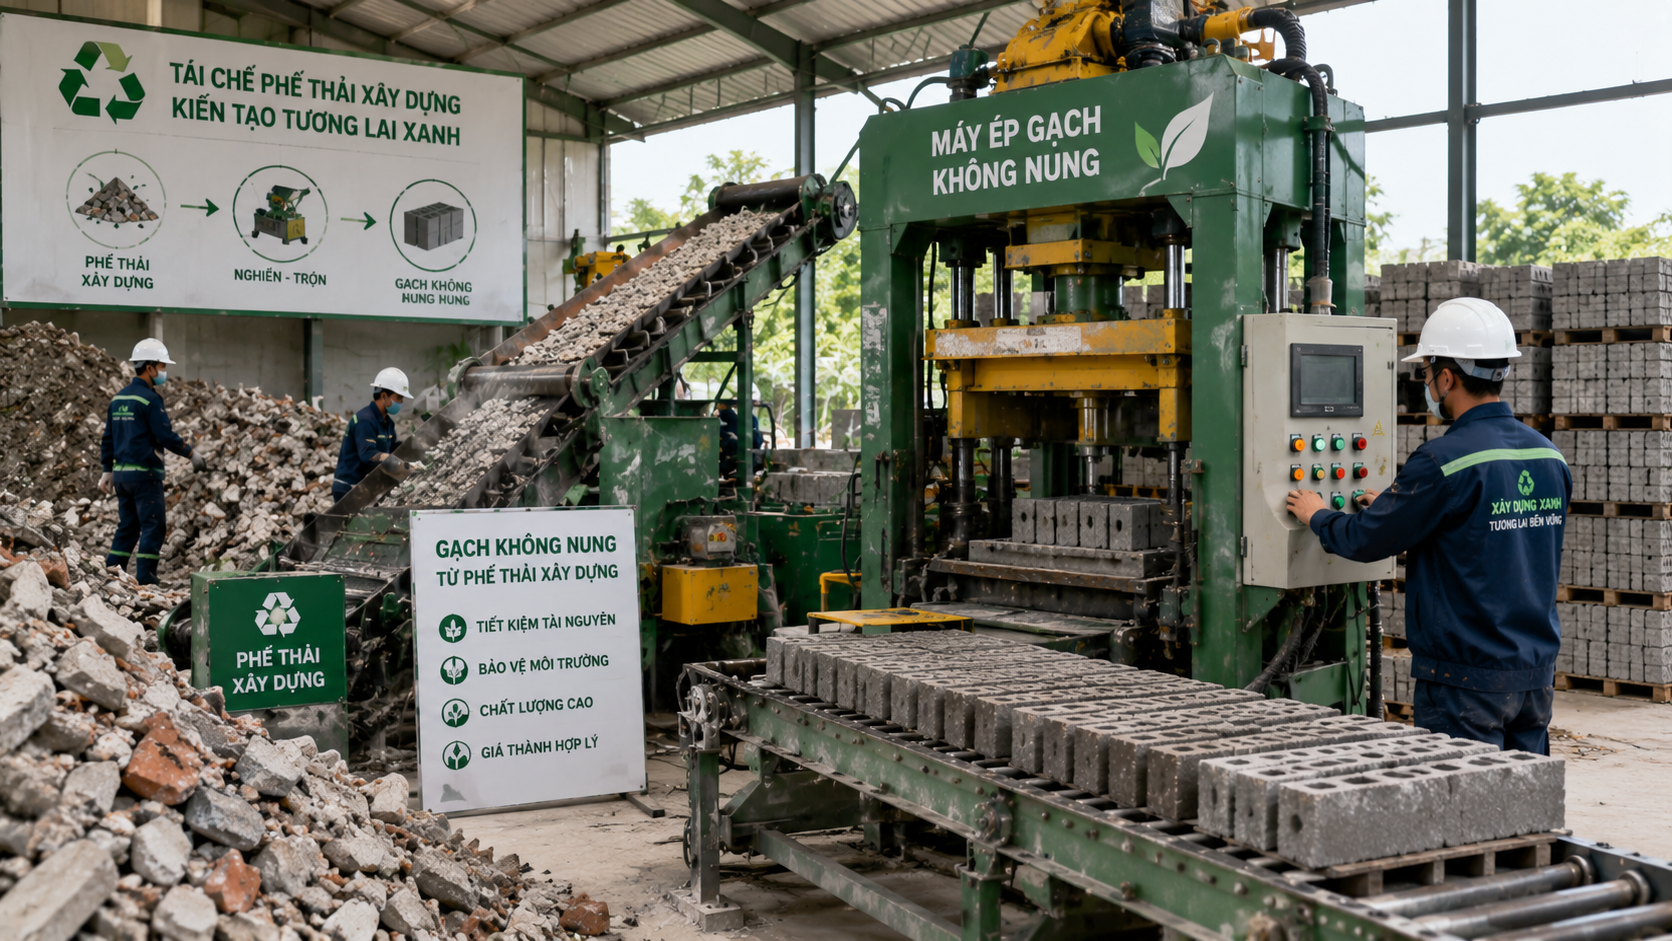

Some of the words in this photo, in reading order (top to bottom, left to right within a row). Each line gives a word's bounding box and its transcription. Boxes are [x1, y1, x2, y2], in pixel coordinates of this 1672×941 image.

[169, 59, 204, 86] TÁI
[210, 64, 256, 92] CHẾ
[261, 70, 304, 98] PHẾ
[307, 75, 356, 104] THẢI
[361, 82, 400, 108] XÂY
[406, 90, 461, 116] DỰNG
[231, 103, 276, 132] TẠO
[282, 108, 358, 136] TƯƠNG
[365, 118, 396, 140] LAI
[403, 121, 460, 146] XANH
[932, 120, 982, 157] MÁY
[989, 114, 1020, 149] ÉP
[1027, 105, 1101, 148] GẠCH
[933, 157, 1017, 196] KHÔNG
[1025, 148, 1100, 184] NUNG
[436, 538, 490, 562] GẠCH
[496, 532, 562, 556] KHÔNG
[567, 535, 616, 554] NUNG
[436, 567, 460, 586] TỪ
[464, 564, 496, 586] PHẾ
[541, 562, 571, 582] XÂY
[576, 563, 618, 583] DỰNG
[476, 615, 504, 633] TIẾT
[508, 615, 539, 633] KIỆM
[542, 614, 561, 629] TÀI
[236, 644, 273, 669] PHẾ
[278, 644, 320, 666] THẢI
[510, 658, 526, 675] VỆ
[530, 656, 554, 672] MÔI
[557, 653, 610, 670] TRƯỜNG
[232, 672, 268, 694] XÂY
[274, 670, 325, 694] DỰNG
[480, 698, 515, 716] CHẤT
[519, 698, 564, 715] LƯỢNG
[567, 696, 594, 710] CAO
[481, 742, 504, 758] GIÁ
[507, 740, 552, 756] THÀNH
[556, 737, 582, 754] HỢP
[585, 734, 598, 749] LÝ
